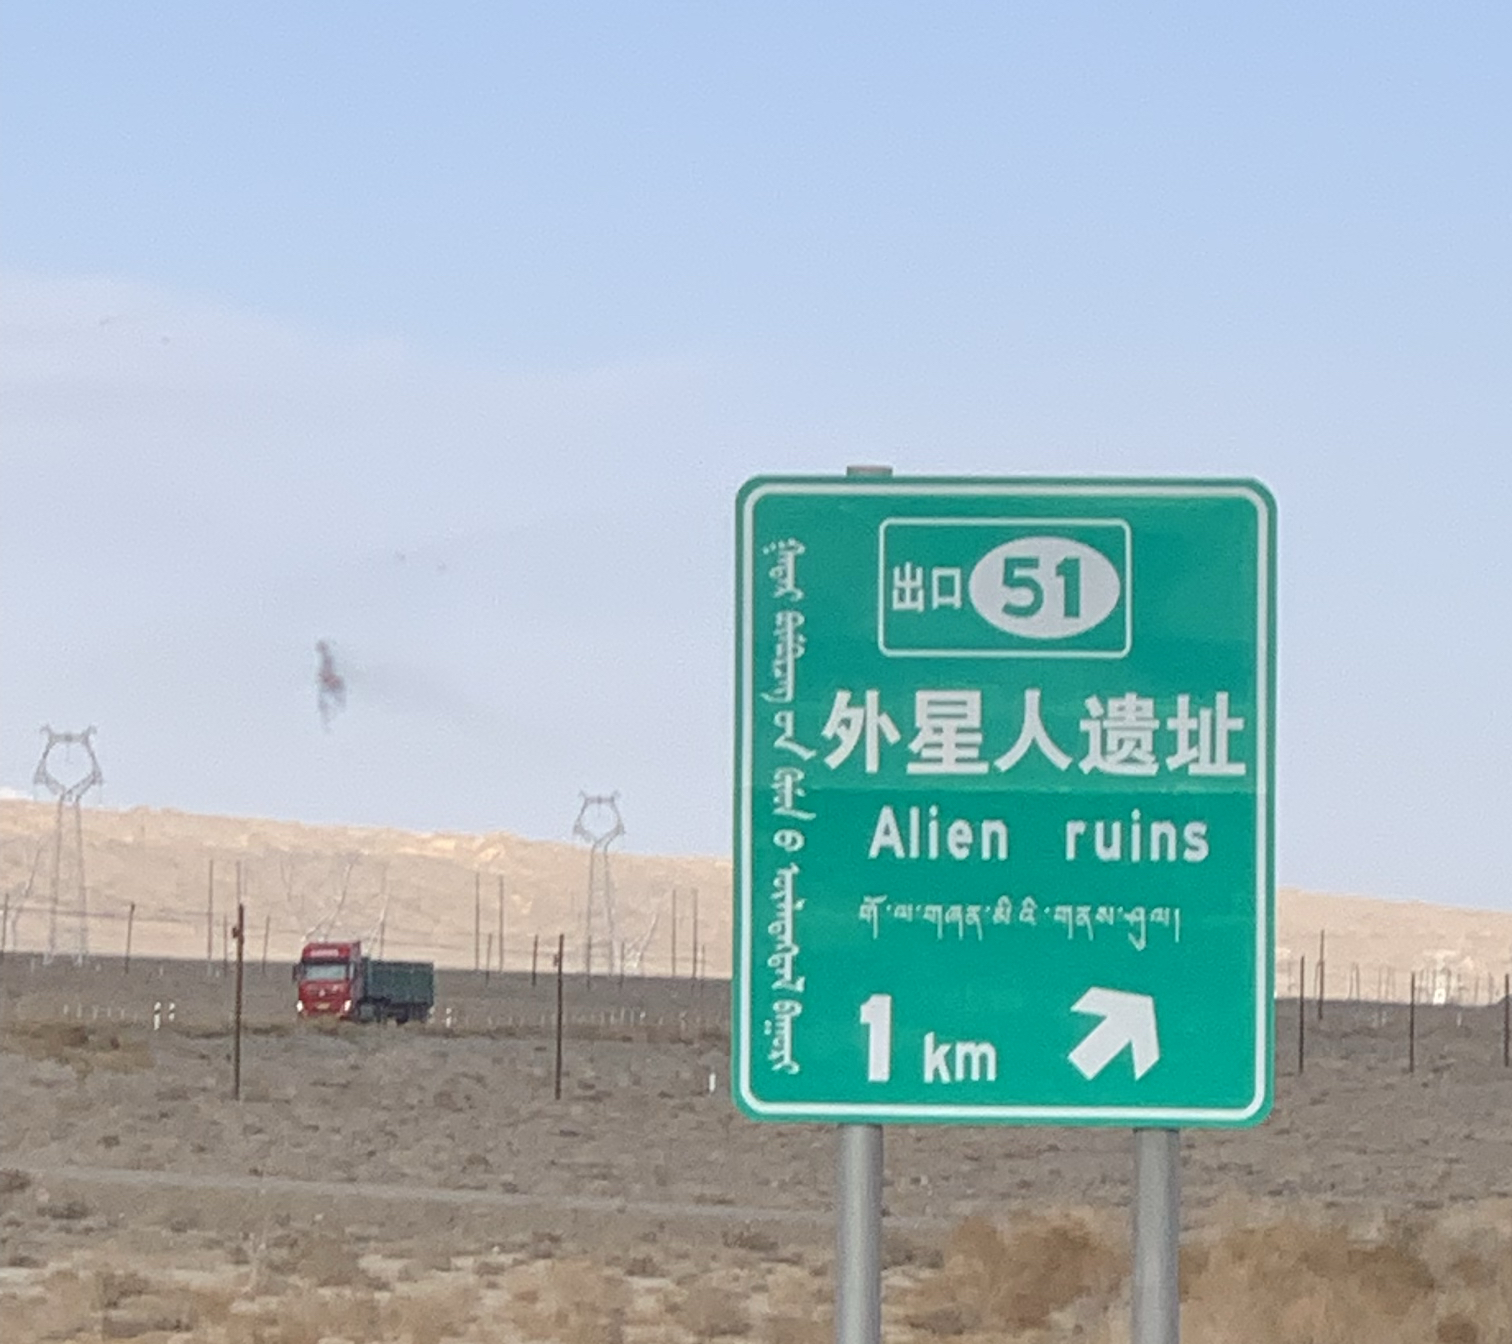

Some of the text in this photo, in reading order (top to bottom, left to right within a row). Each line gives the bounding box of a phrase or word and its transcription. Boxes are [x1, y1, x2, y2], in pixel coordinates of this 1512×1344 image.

[892, 556, 1081, 618] 出口 51
[821, 688, 1247, 776] 外星人遗址
[869, 805, 1209, 862] Alien ruins
[859, 994, 997, 1083] 1 km
